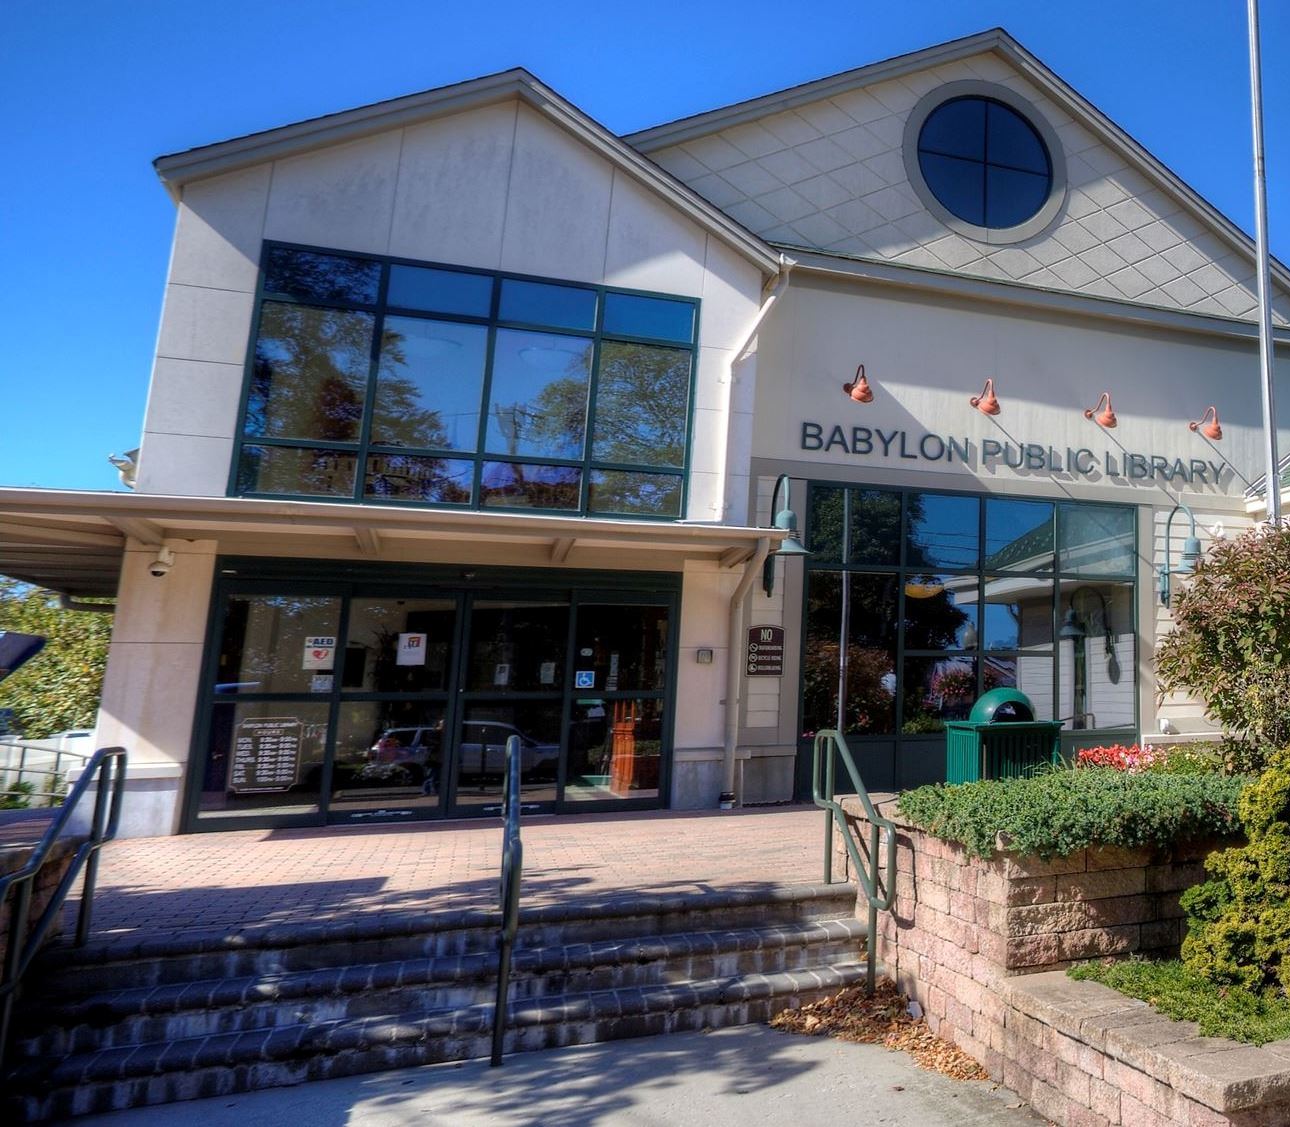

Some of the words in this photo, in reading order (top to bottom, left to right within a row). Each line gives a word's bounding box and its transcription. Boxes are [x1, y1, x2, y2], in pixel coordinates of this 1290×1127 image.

[801, 422, 969, 463] BABYLON
[982, 439, 1094, 475] PUBLIC
[1105, 451, 1226, 485] LIBRARY
[761, 629, 773, 641] NO
